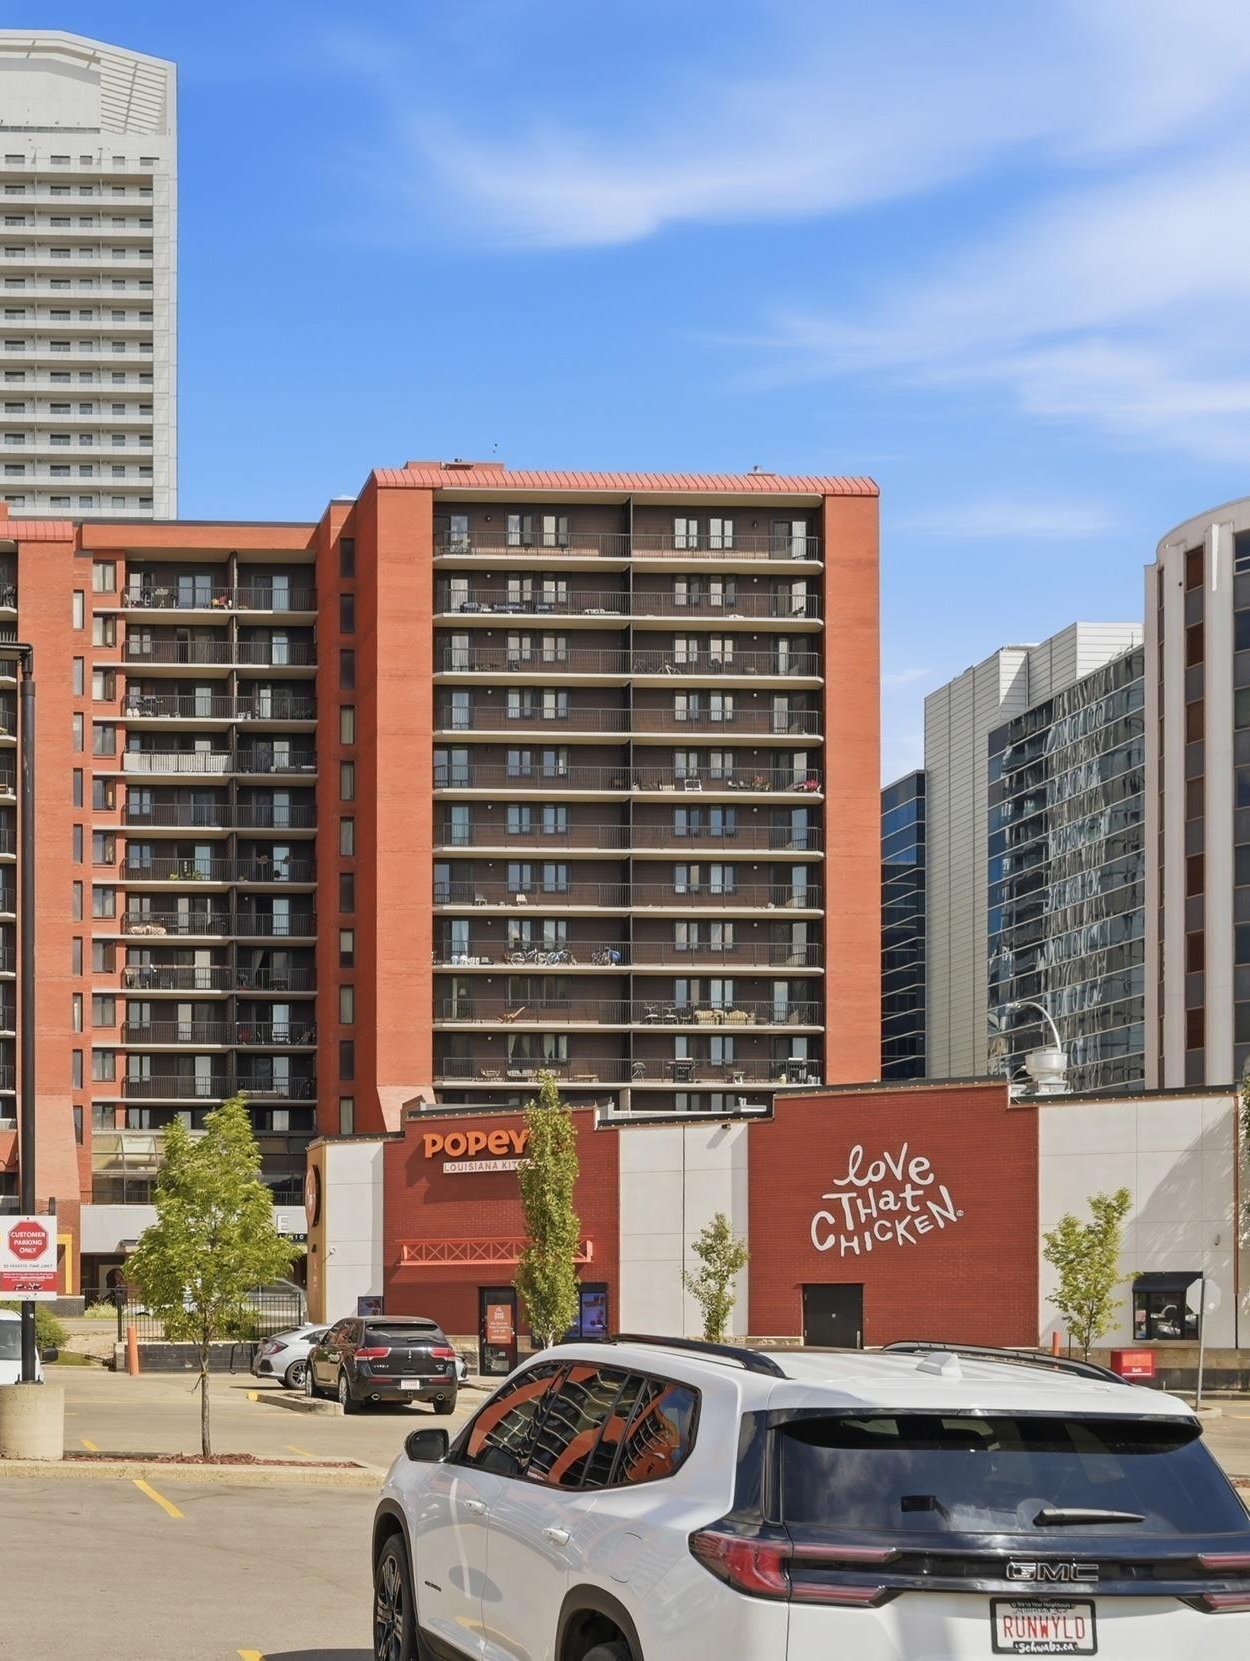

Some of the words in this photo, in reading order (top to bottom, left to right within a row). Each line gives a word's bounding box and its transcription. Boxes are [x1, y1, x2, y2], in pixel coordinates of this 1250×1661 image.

[423, 1129, 531, 1158] POPEY
[444, 1161, 499, 1172] LOUISIANA
[1006, 1562, 1099, 1581] GMC
[1003, 1615, 1085, 1639] RUNWYLD
